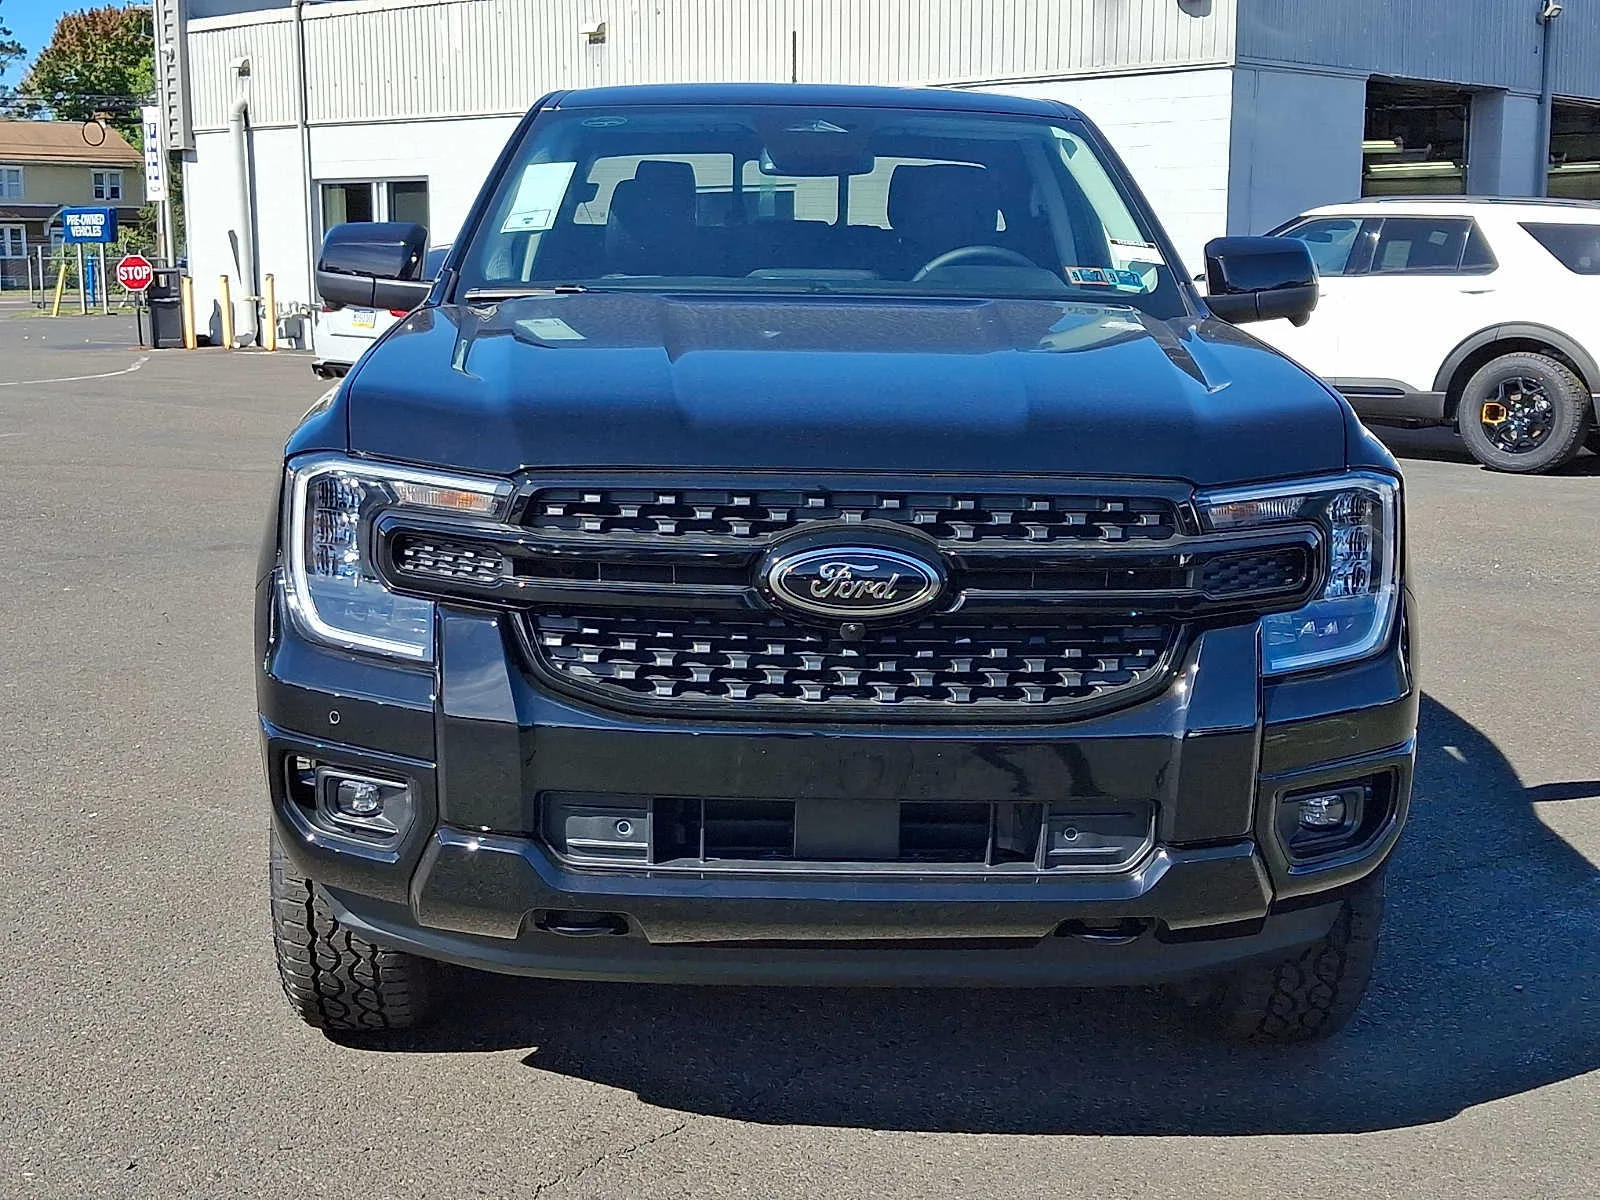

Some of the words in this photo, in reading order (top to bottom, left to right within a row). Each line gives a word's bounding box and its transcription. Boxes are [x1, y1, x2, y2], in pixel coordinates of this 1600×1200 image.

[66, 214, 105, 226] PRE-OWNED
[71, 226, 102, 237] VEHICLES
[120, 266, 150, 281] STOP
[810, 562, 900, 599] Ford
